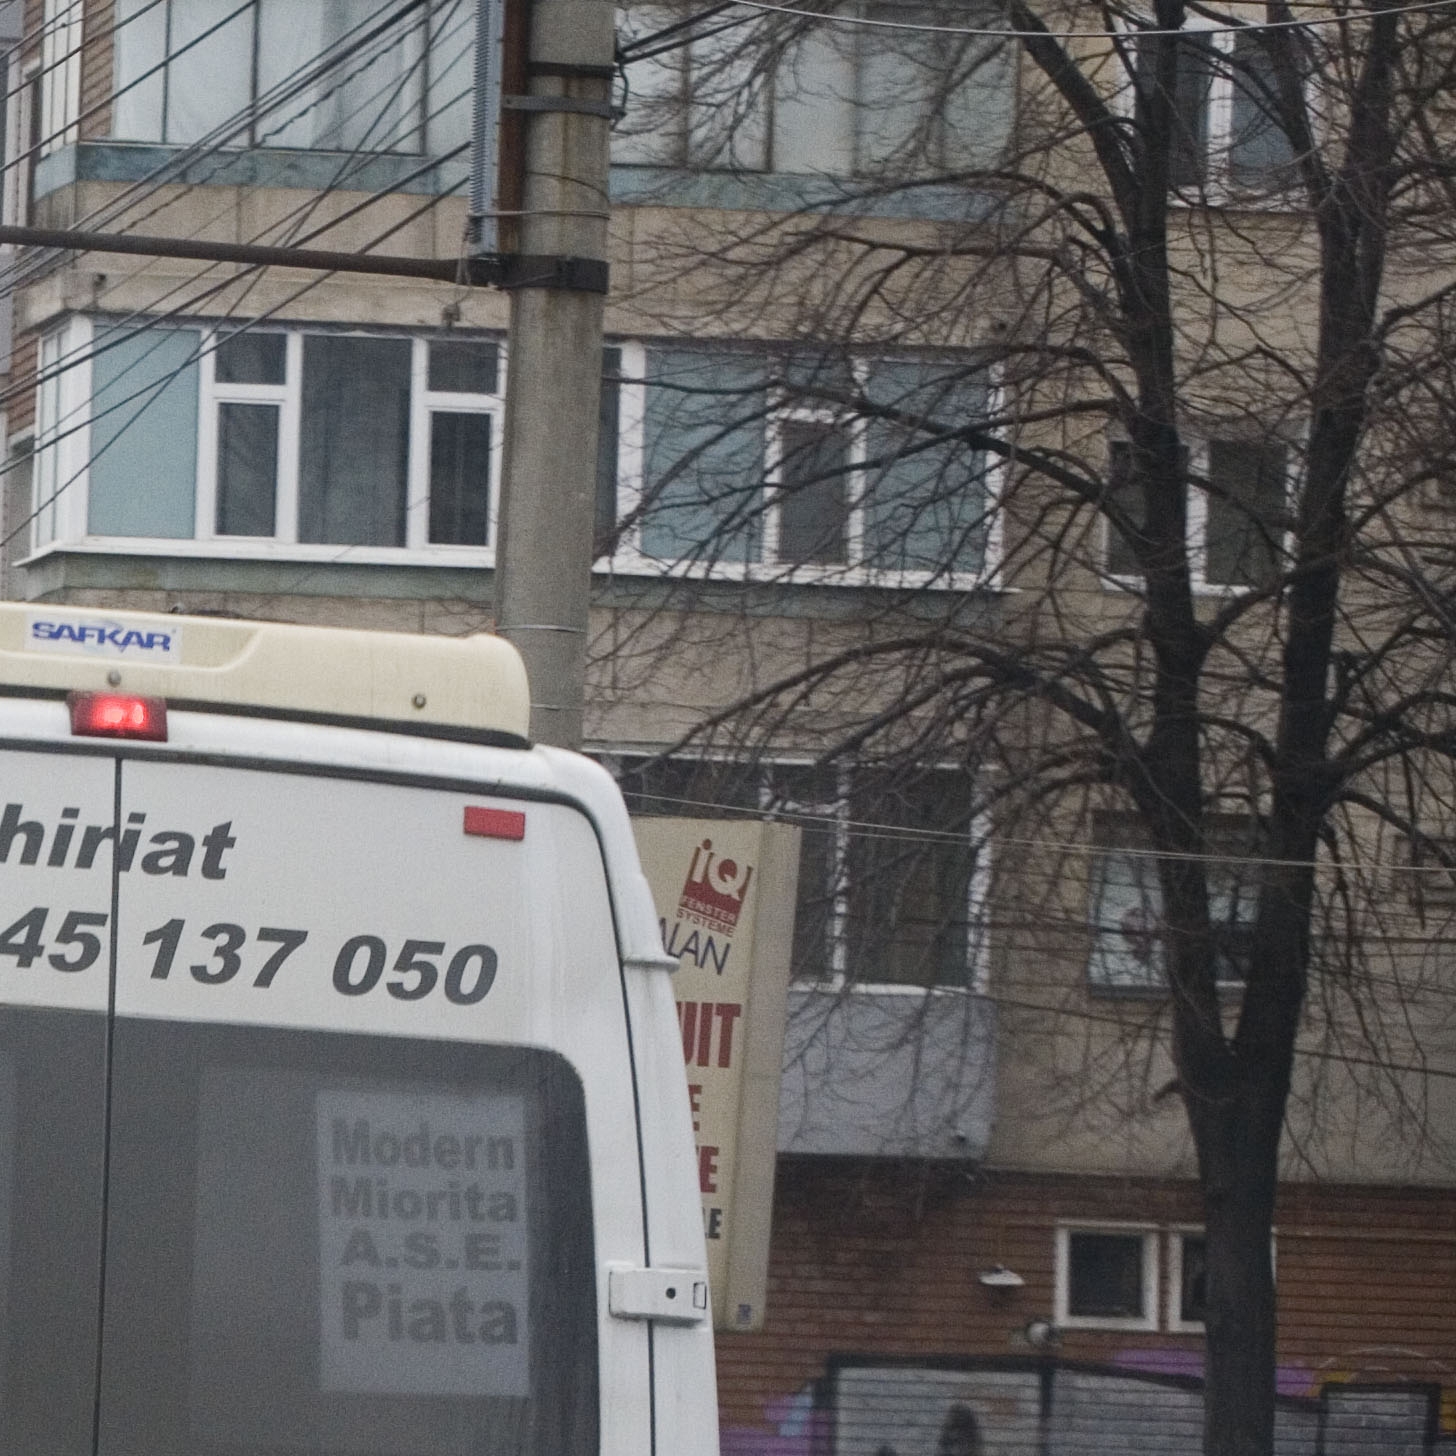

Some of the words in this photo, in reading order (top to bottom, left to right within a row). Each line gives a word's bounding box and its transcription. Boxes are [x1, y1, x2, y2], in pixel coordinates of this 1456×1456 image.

[32, 621, 171, 652] SAFKAR
[676, 908, 736, 938] SYSTEME
[681, 897, 737, 925] FENSTER
[139, 919, 307, 988] 137
[330, 935, 500, 1005] 050
[331, 1117, 516, 1172] Modern
[329, 1175, 520, 1224] Miorita
[341, 1230, 521, 1271] A.S.E.
[341, 1281, 520, 1346] Piata
